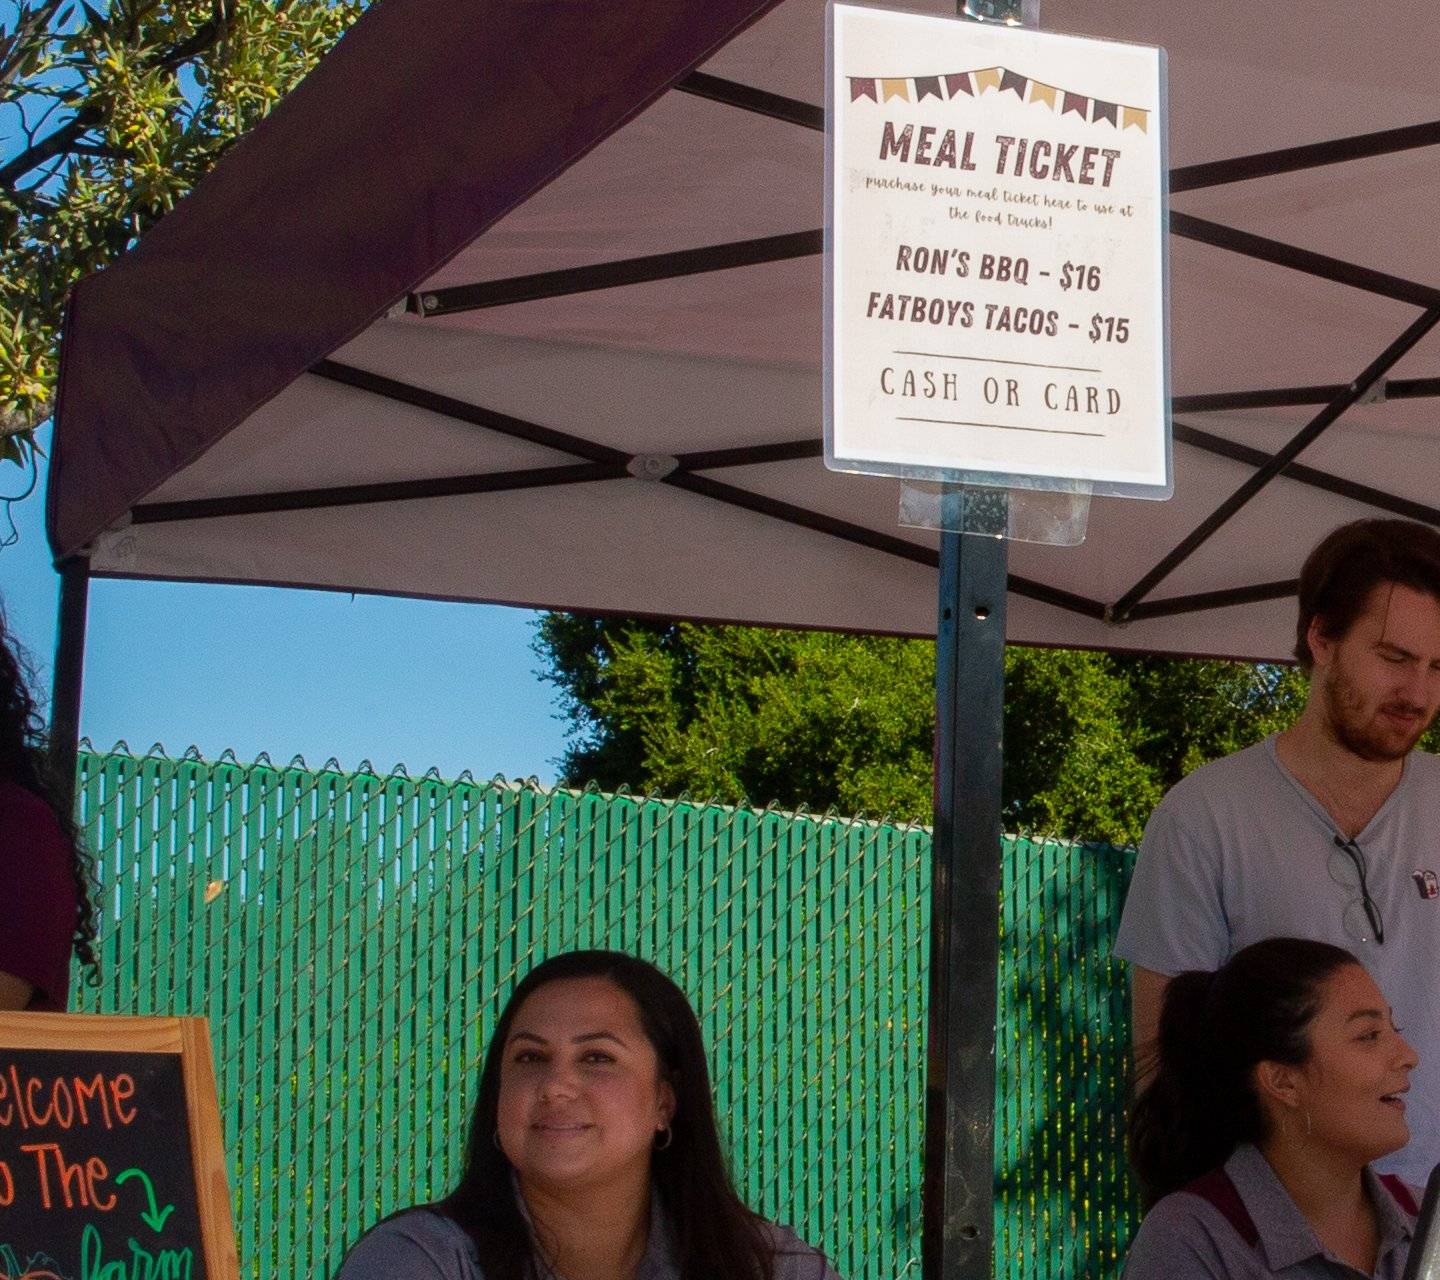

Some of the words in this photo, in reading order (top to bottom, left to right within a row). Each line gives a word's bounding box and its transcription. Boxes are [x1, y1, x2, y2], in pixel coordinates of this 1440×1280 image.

[878, 121, 977, 172] MEAL
[994, 135, 1121, 188] TICKET
[865, 175, 926, 192] purchase
[930, 182, 961, 197] your
[966, 187, 999, 201] meal
[1003, 189, 1039, 206] ticket
[1043, 195, 1071, 210] here
[1076, 198, 1088, 212] to
[1094, 204, 1115, 215] use
[1119, 204, 1135, 217] at
[949, 206, 970, 220] the
[973, 209, 1002, 225] food
[1007, 212, 1053, 229] trucks!
[895, 244, 971, 279] RON'S
[978, 255, 1029, 287] BBQ
[1059, 260, 1101, 292] $16
[866, 291, 975, 328] FATBOYS
[984, 303, 1059, 337] TACOS
[1088, 312, 1130, 344] $15
[879, 366, 959, 402] CASH
[982, 376, 1021, 407] OR
[1043, 382, 1123, 416] CARD
[20, 1142, 120, 1213] The
